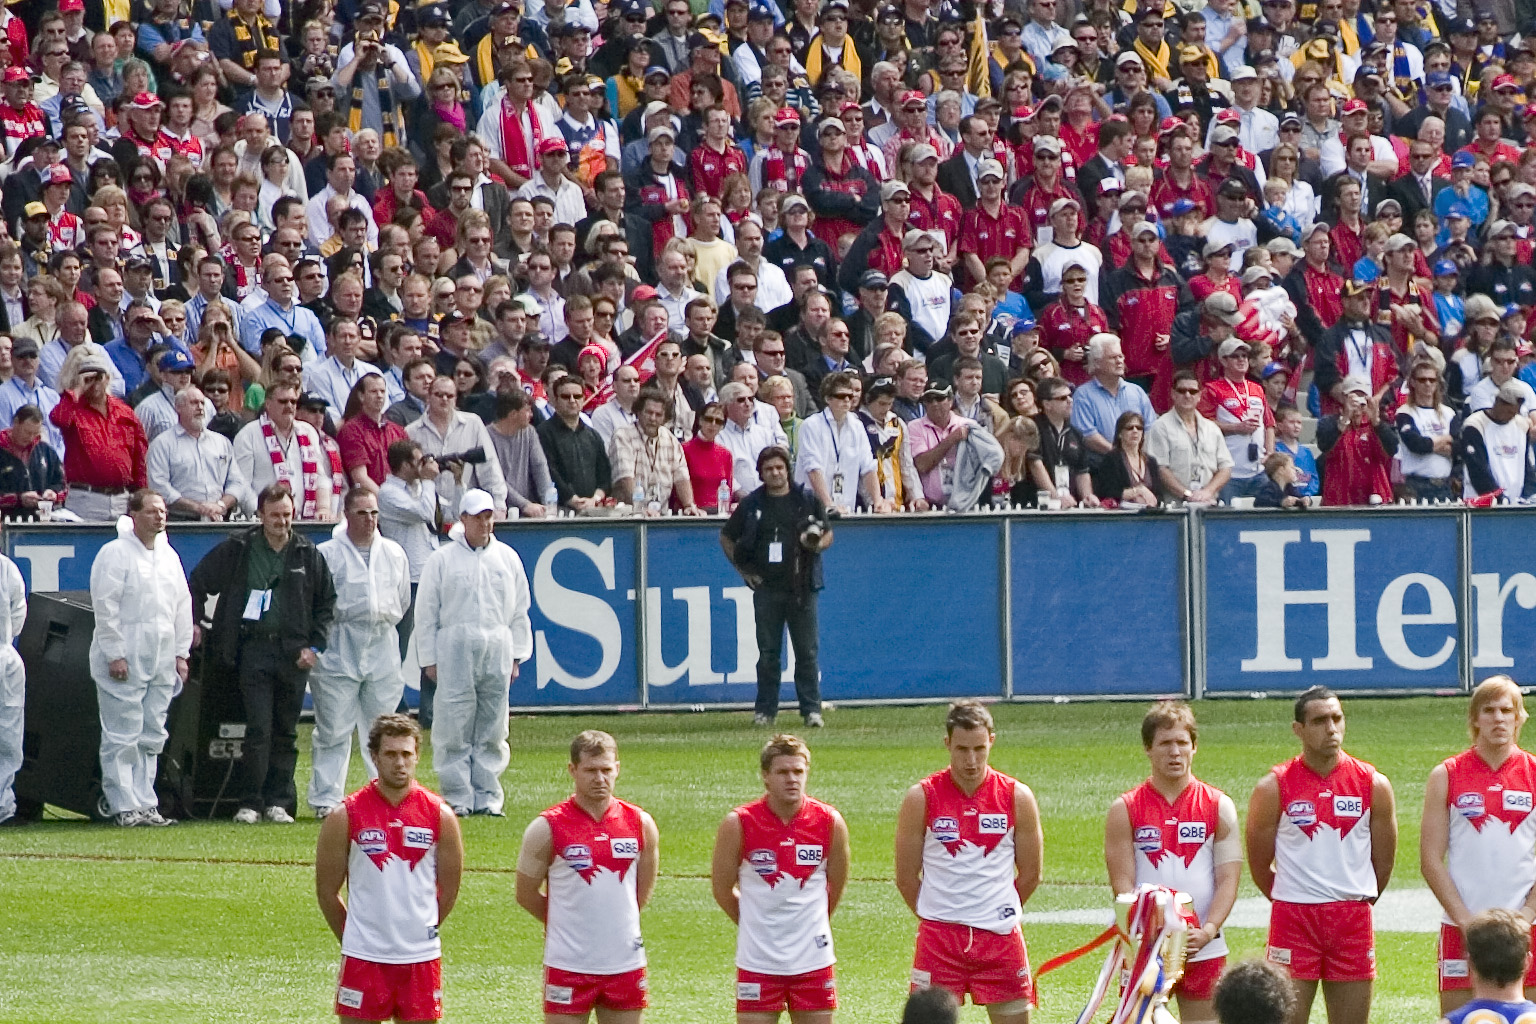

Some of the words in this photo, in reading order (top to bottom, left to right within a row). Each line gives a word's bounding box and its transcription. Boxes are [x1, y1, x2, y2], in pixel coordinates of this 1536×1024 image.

[534, 536, 822, 690] Sun
[1337, 800, 1361, 812] QBE
[1507, 794, 1531, 807] QBE
[981, 818, 1006, 829] QBE
[1180, 826, 1205, 838] QBE
[614, 842, 637, 854] QBE
[798, 849, 822, 861] QBE
